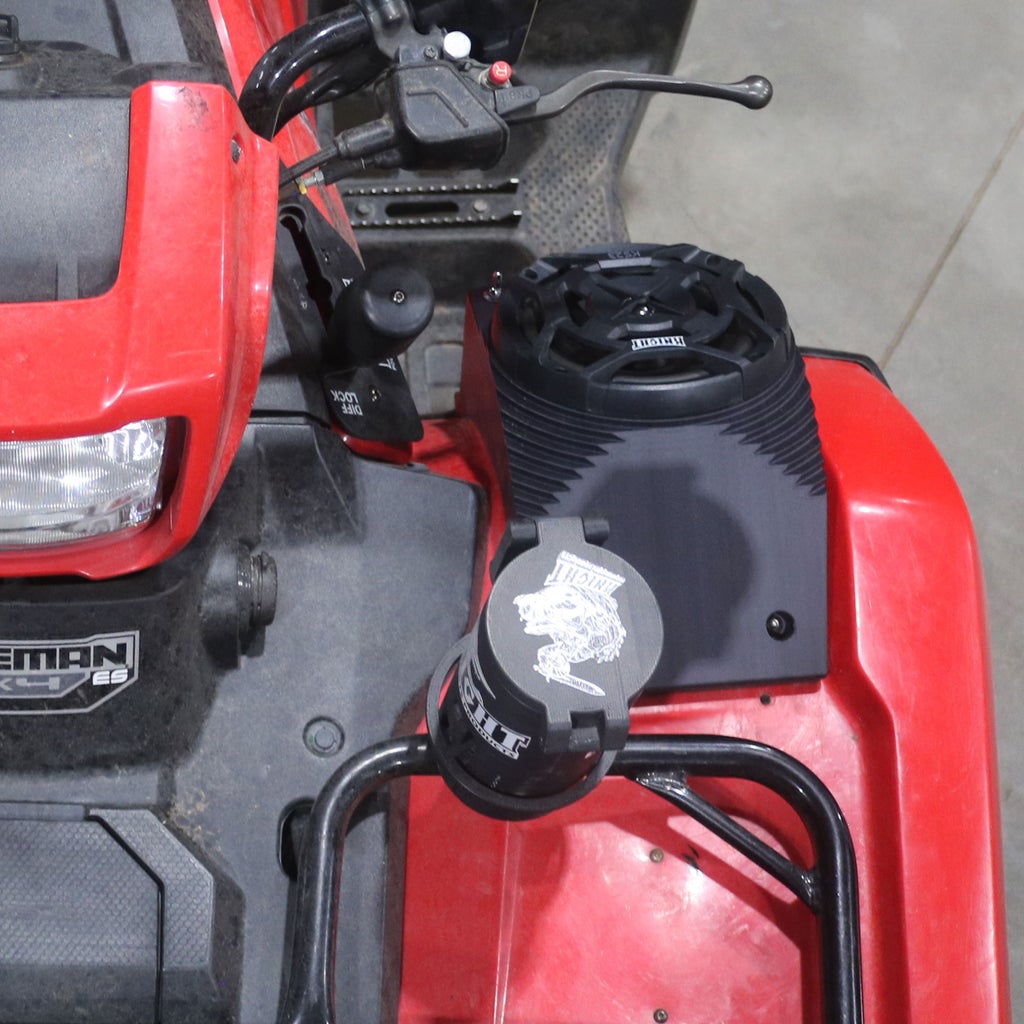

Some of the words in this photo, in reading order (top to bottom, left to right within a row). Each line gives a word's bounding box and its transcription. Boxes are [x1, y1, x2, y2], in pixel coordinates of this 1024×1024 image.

[631, 335, 687, 351] KNIGHT
[330, 389, 359, 404] LOCK
[341, 403, 363, 416] DIFF
[92, 669, 129, 686] ES
